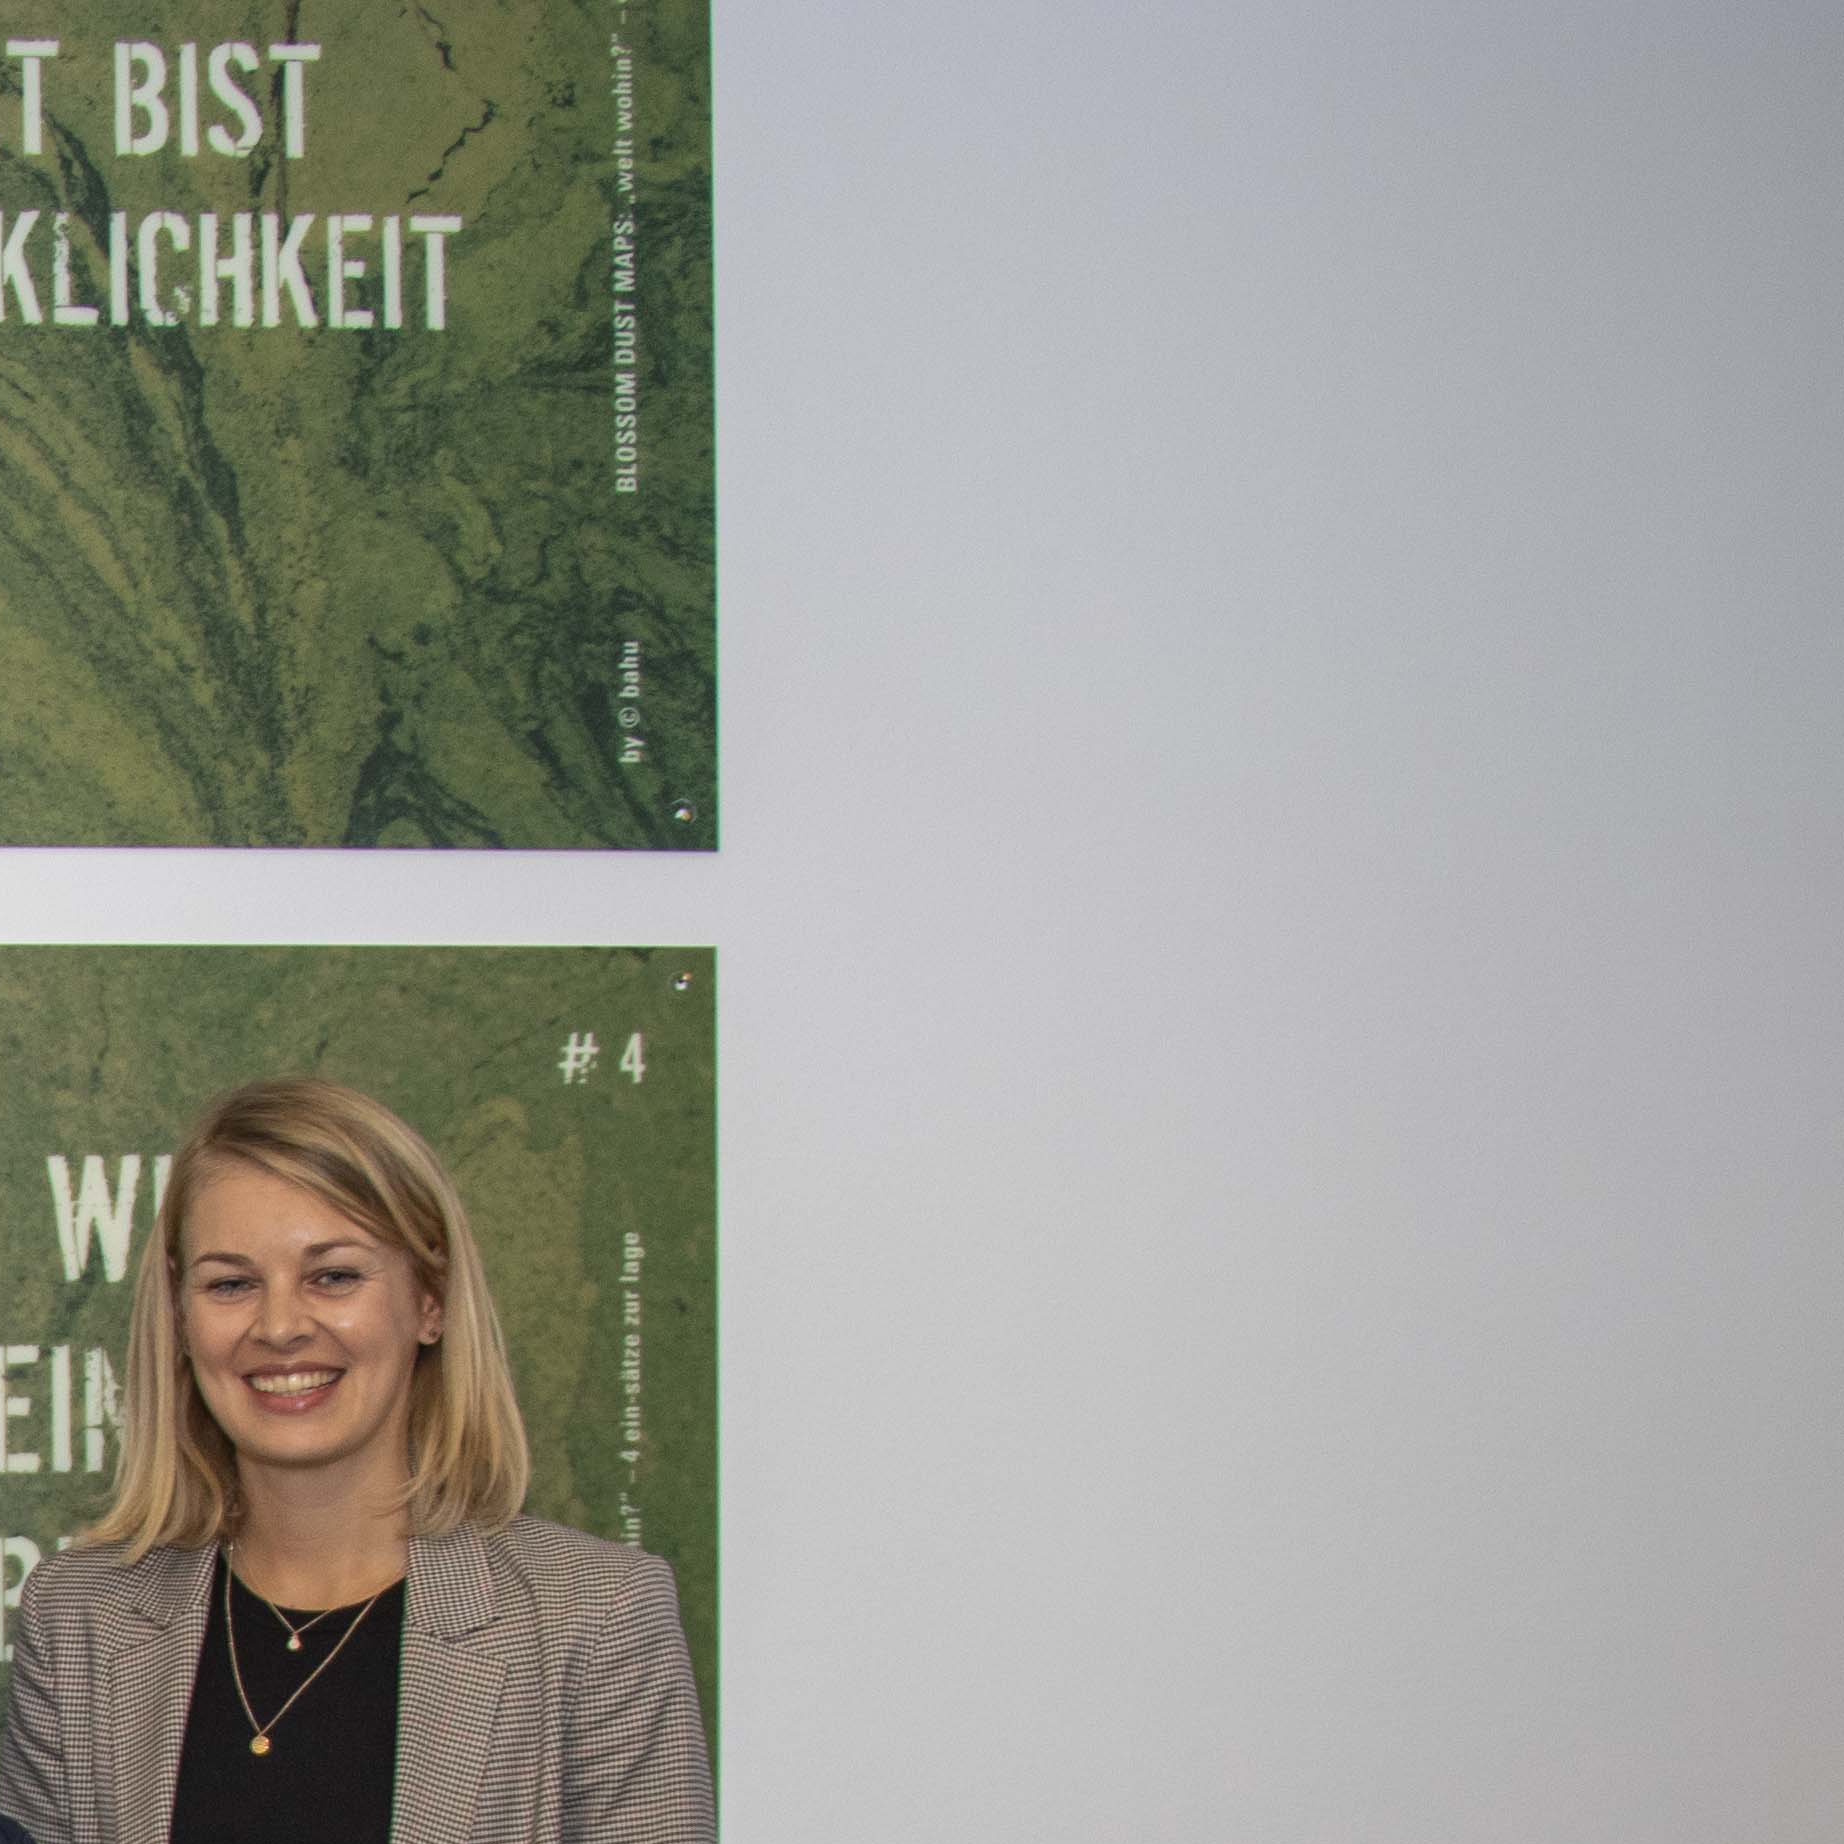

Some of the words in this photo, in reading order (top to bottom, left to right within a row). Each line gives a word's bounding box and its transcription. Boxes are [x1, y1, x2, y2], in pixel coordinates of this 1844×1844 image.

[114, 39, 322, 159] BIST
[613, 213, 635, 292] MAPS:
[615, 301, 637, 365] DUST
[615, 372, 638, 493] BLOSSOM
[618, 641, 640, 698] bahu
[618, 736, 646, 763] by
[619, 1031, 647, 1084] 4
[619, 1231, 646, 1283] lage
[623, 1290, 641, 1326] zur
